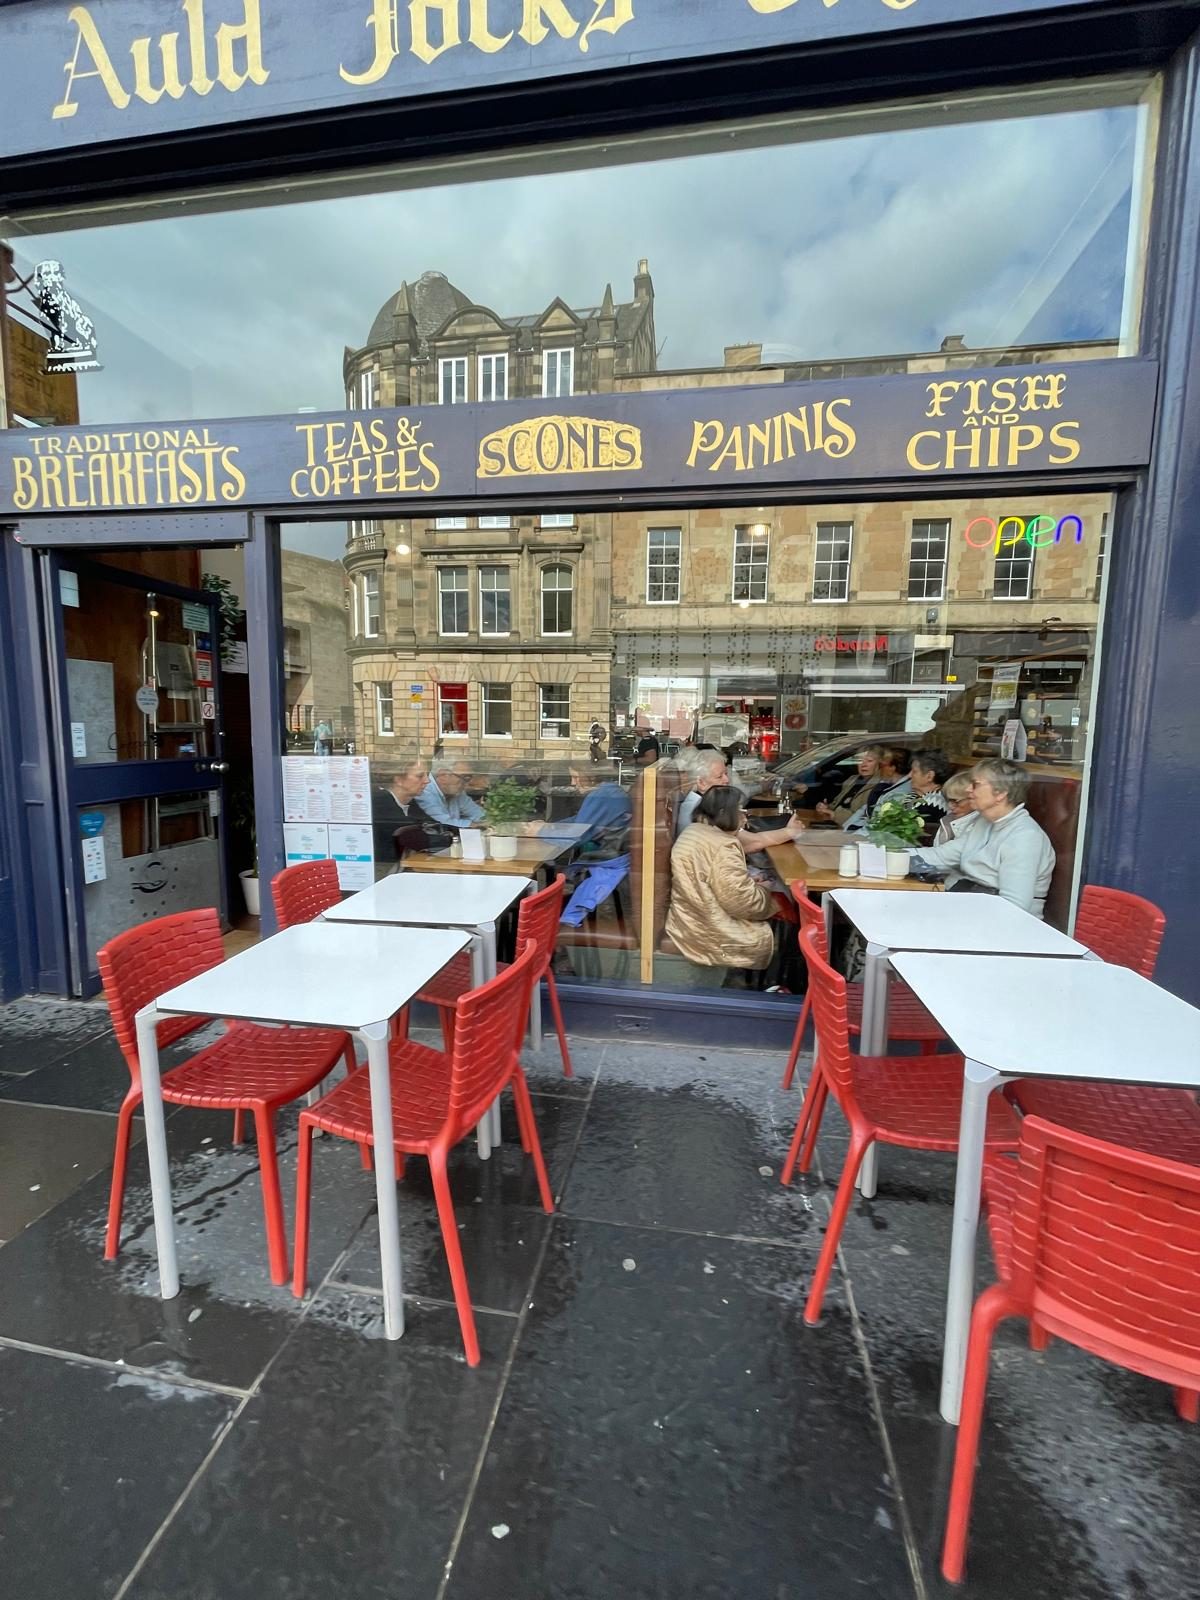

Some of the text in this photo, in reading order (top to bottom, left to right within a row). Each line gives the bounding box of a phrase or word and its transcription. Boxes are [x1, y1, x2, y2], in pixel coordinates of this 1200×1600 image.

[51, 0, 270, 119] Auld
[925, 373, 1067, 418] FISH
[962, 412, 1021, 428] AND
[28, 428, 220, 455] TRADITIONAL
[296, 417, 423, 467] TEAS &
[482, 419, 640, 477] SCONES
[686, 398, 857, 472] PANINIS
[906, 420, 1083, 473] CHIPS
[12, 445, 248, 511] BREAKFASTS
[290, 442, 441, 499] COFFEES
[965, 514, 1083, 556] open
